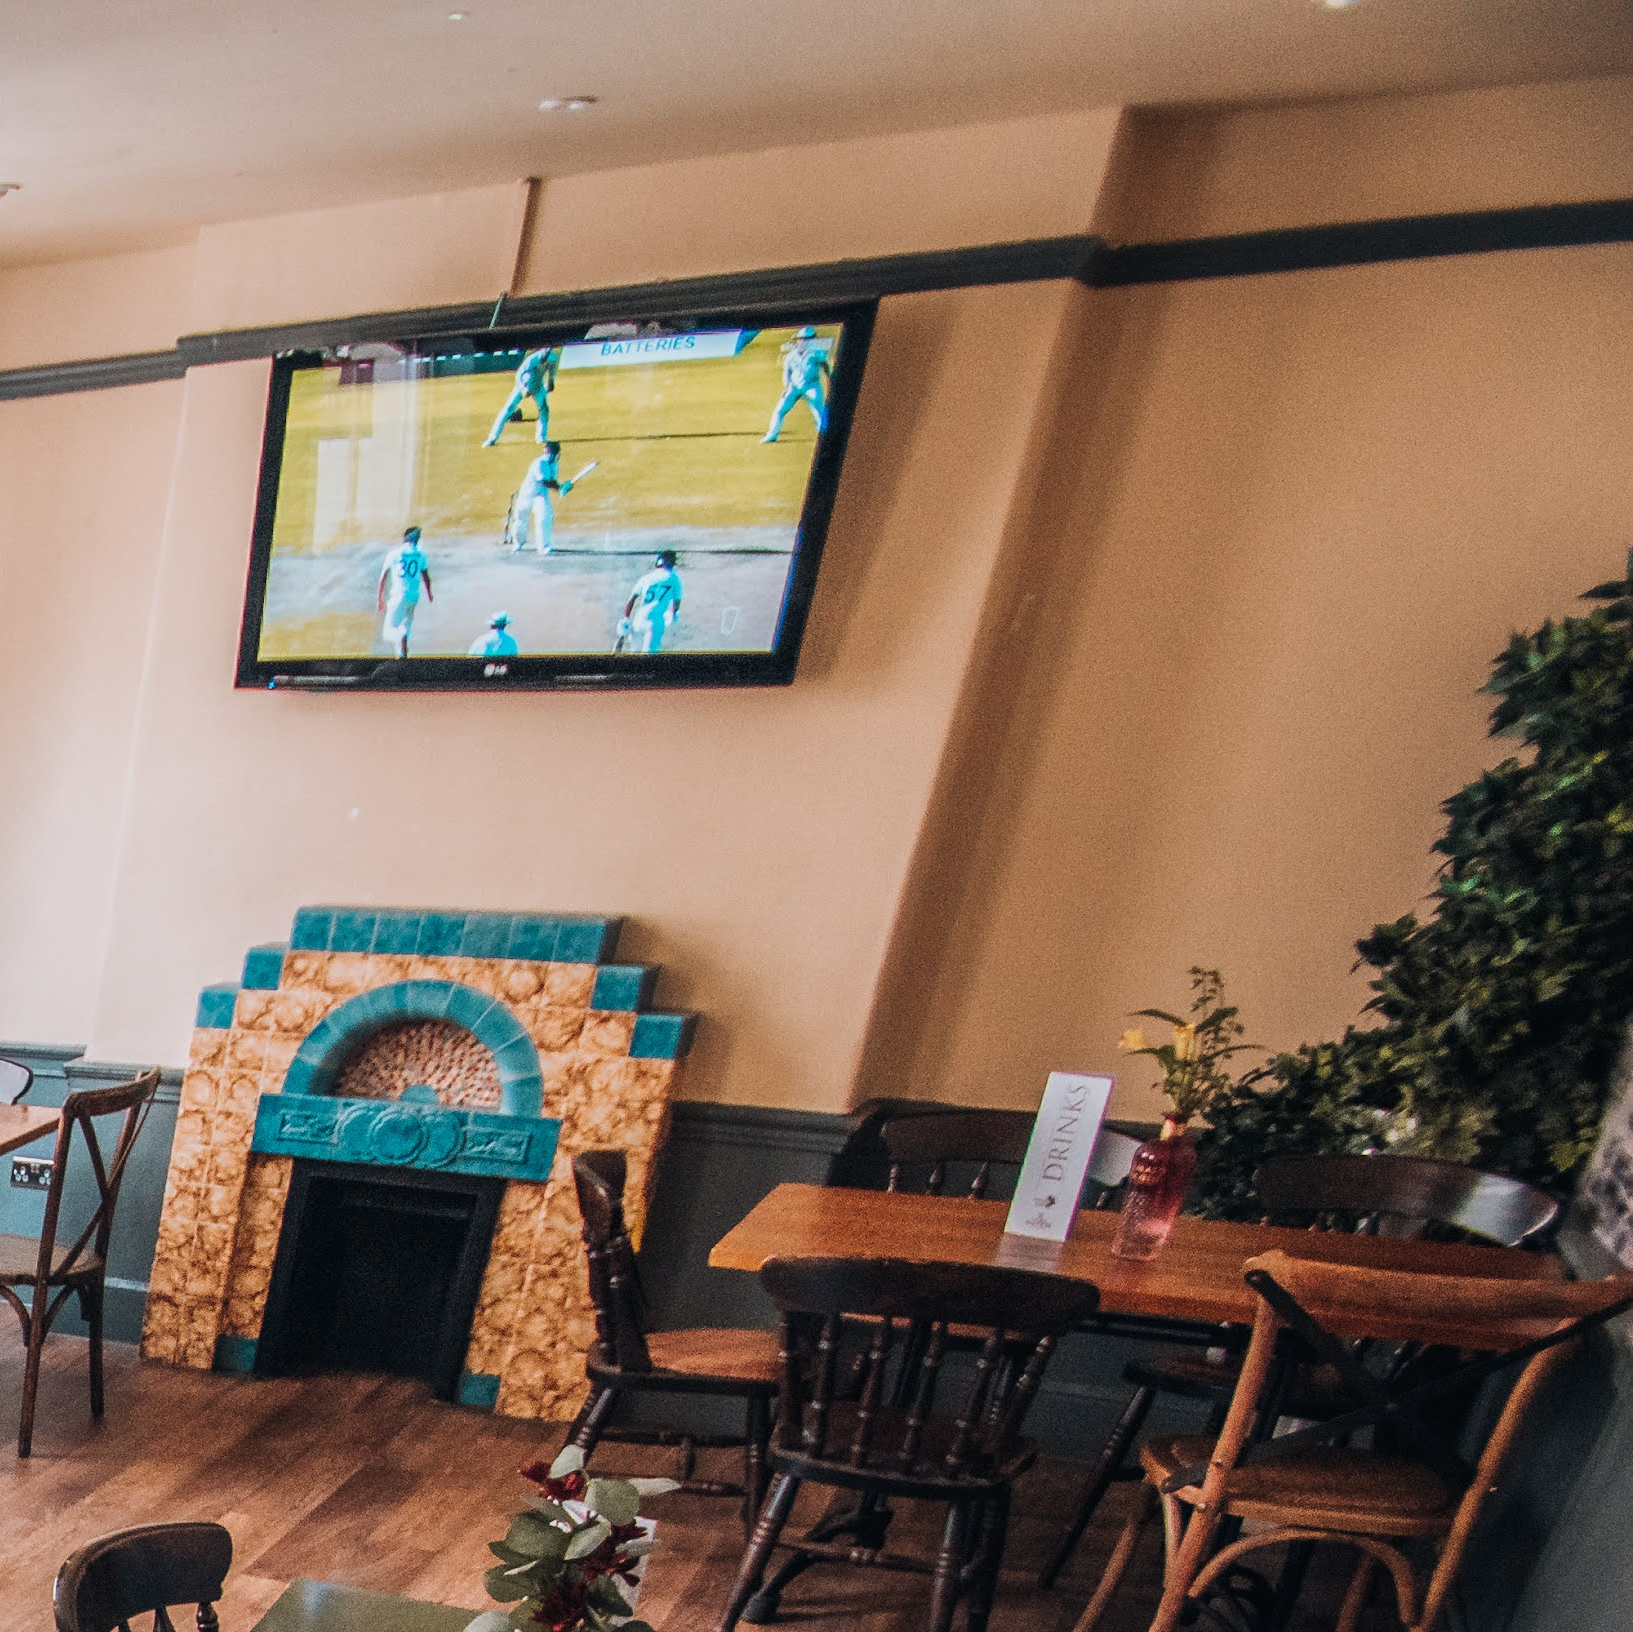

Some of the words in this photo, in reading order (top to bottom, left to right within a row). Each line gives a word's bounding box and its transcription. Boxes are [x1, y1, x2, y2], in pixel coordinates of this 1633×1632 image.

[601, 336, 696, 356] BATTERIES
[399, 559, 418, 578] 30
[1042, 1083, 1088, 1182] DRINKS
